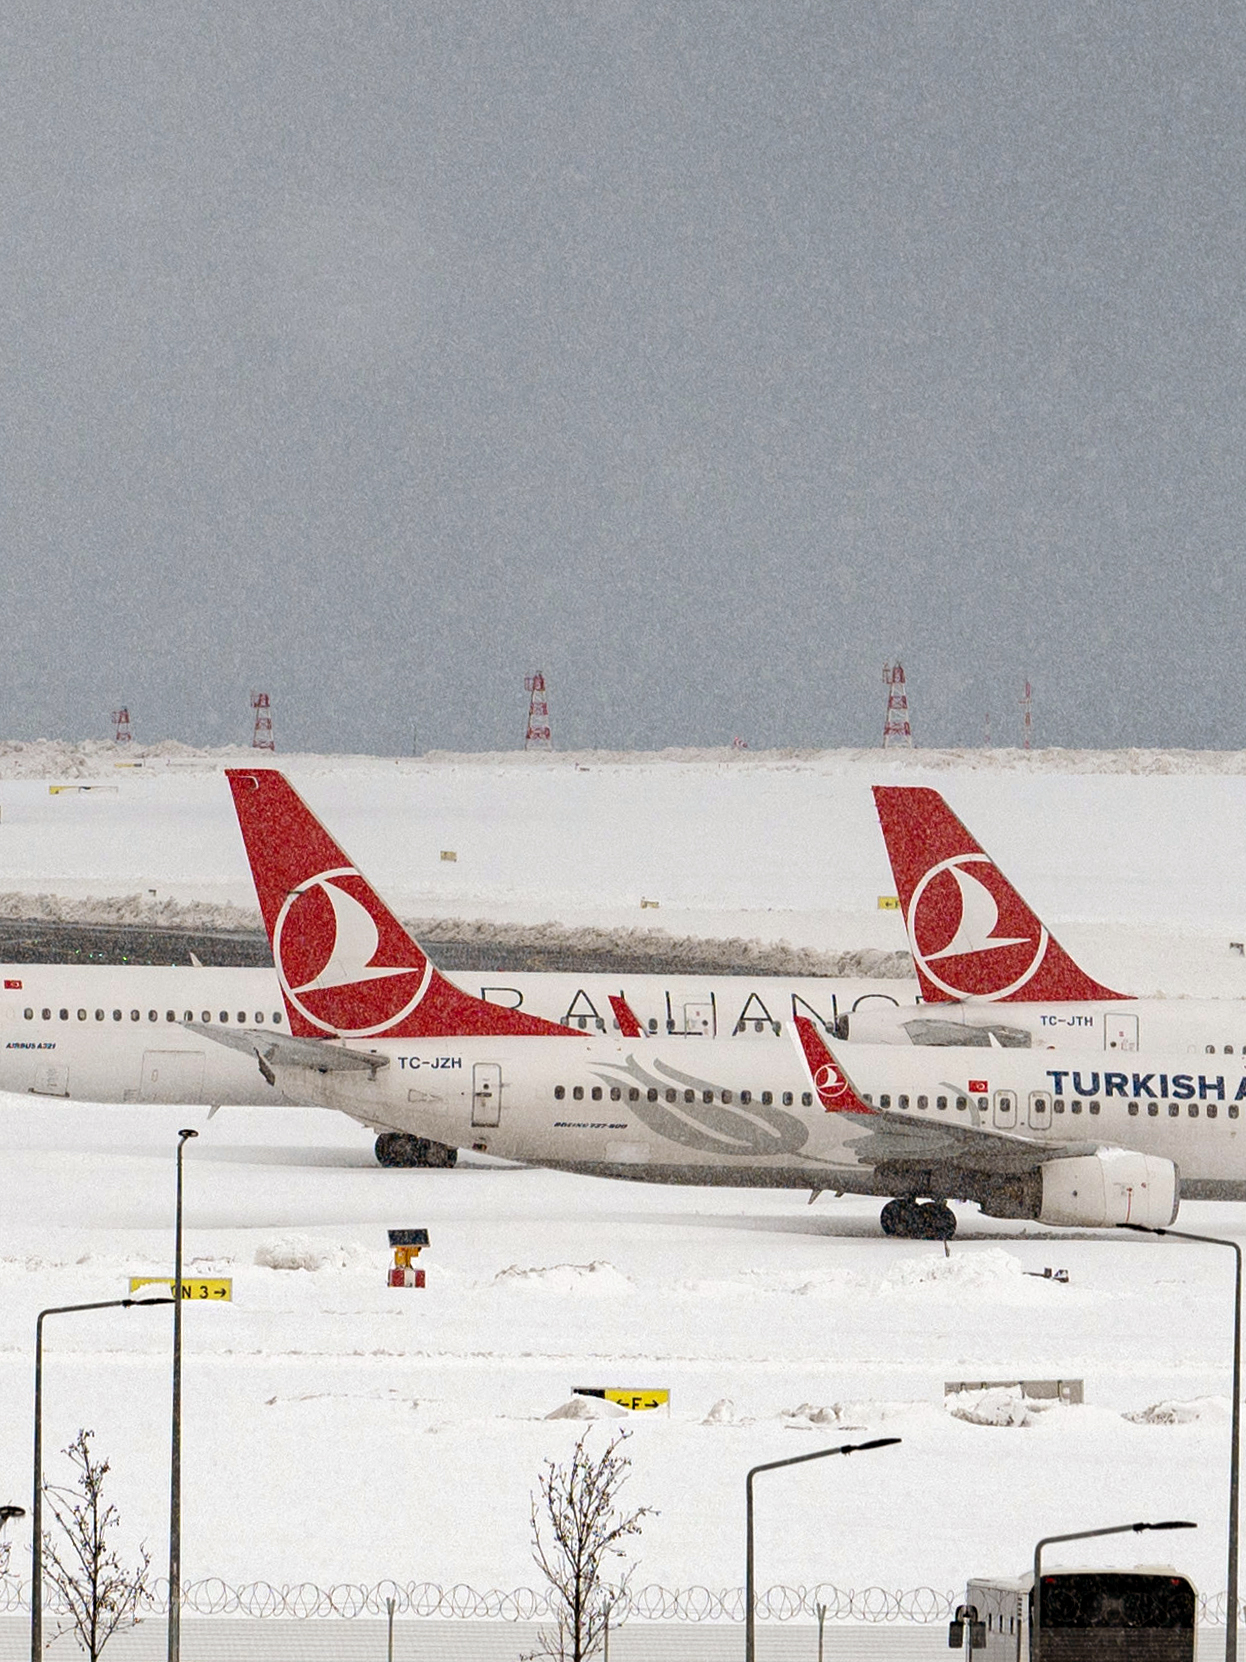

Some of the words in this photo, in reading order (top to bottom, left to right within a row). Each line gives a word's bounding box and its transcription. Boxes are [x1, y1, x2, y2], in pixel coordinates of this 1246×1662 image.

[1040, 1015, 1094, 1027] TC-JTH
[398, 1056, 462, 1069] TC-JZH
[1046, 1070, 1226, 1101] TURKISH
[199, 1286, 209, 1299] 3
[632, 1397, 642, 1410] F
